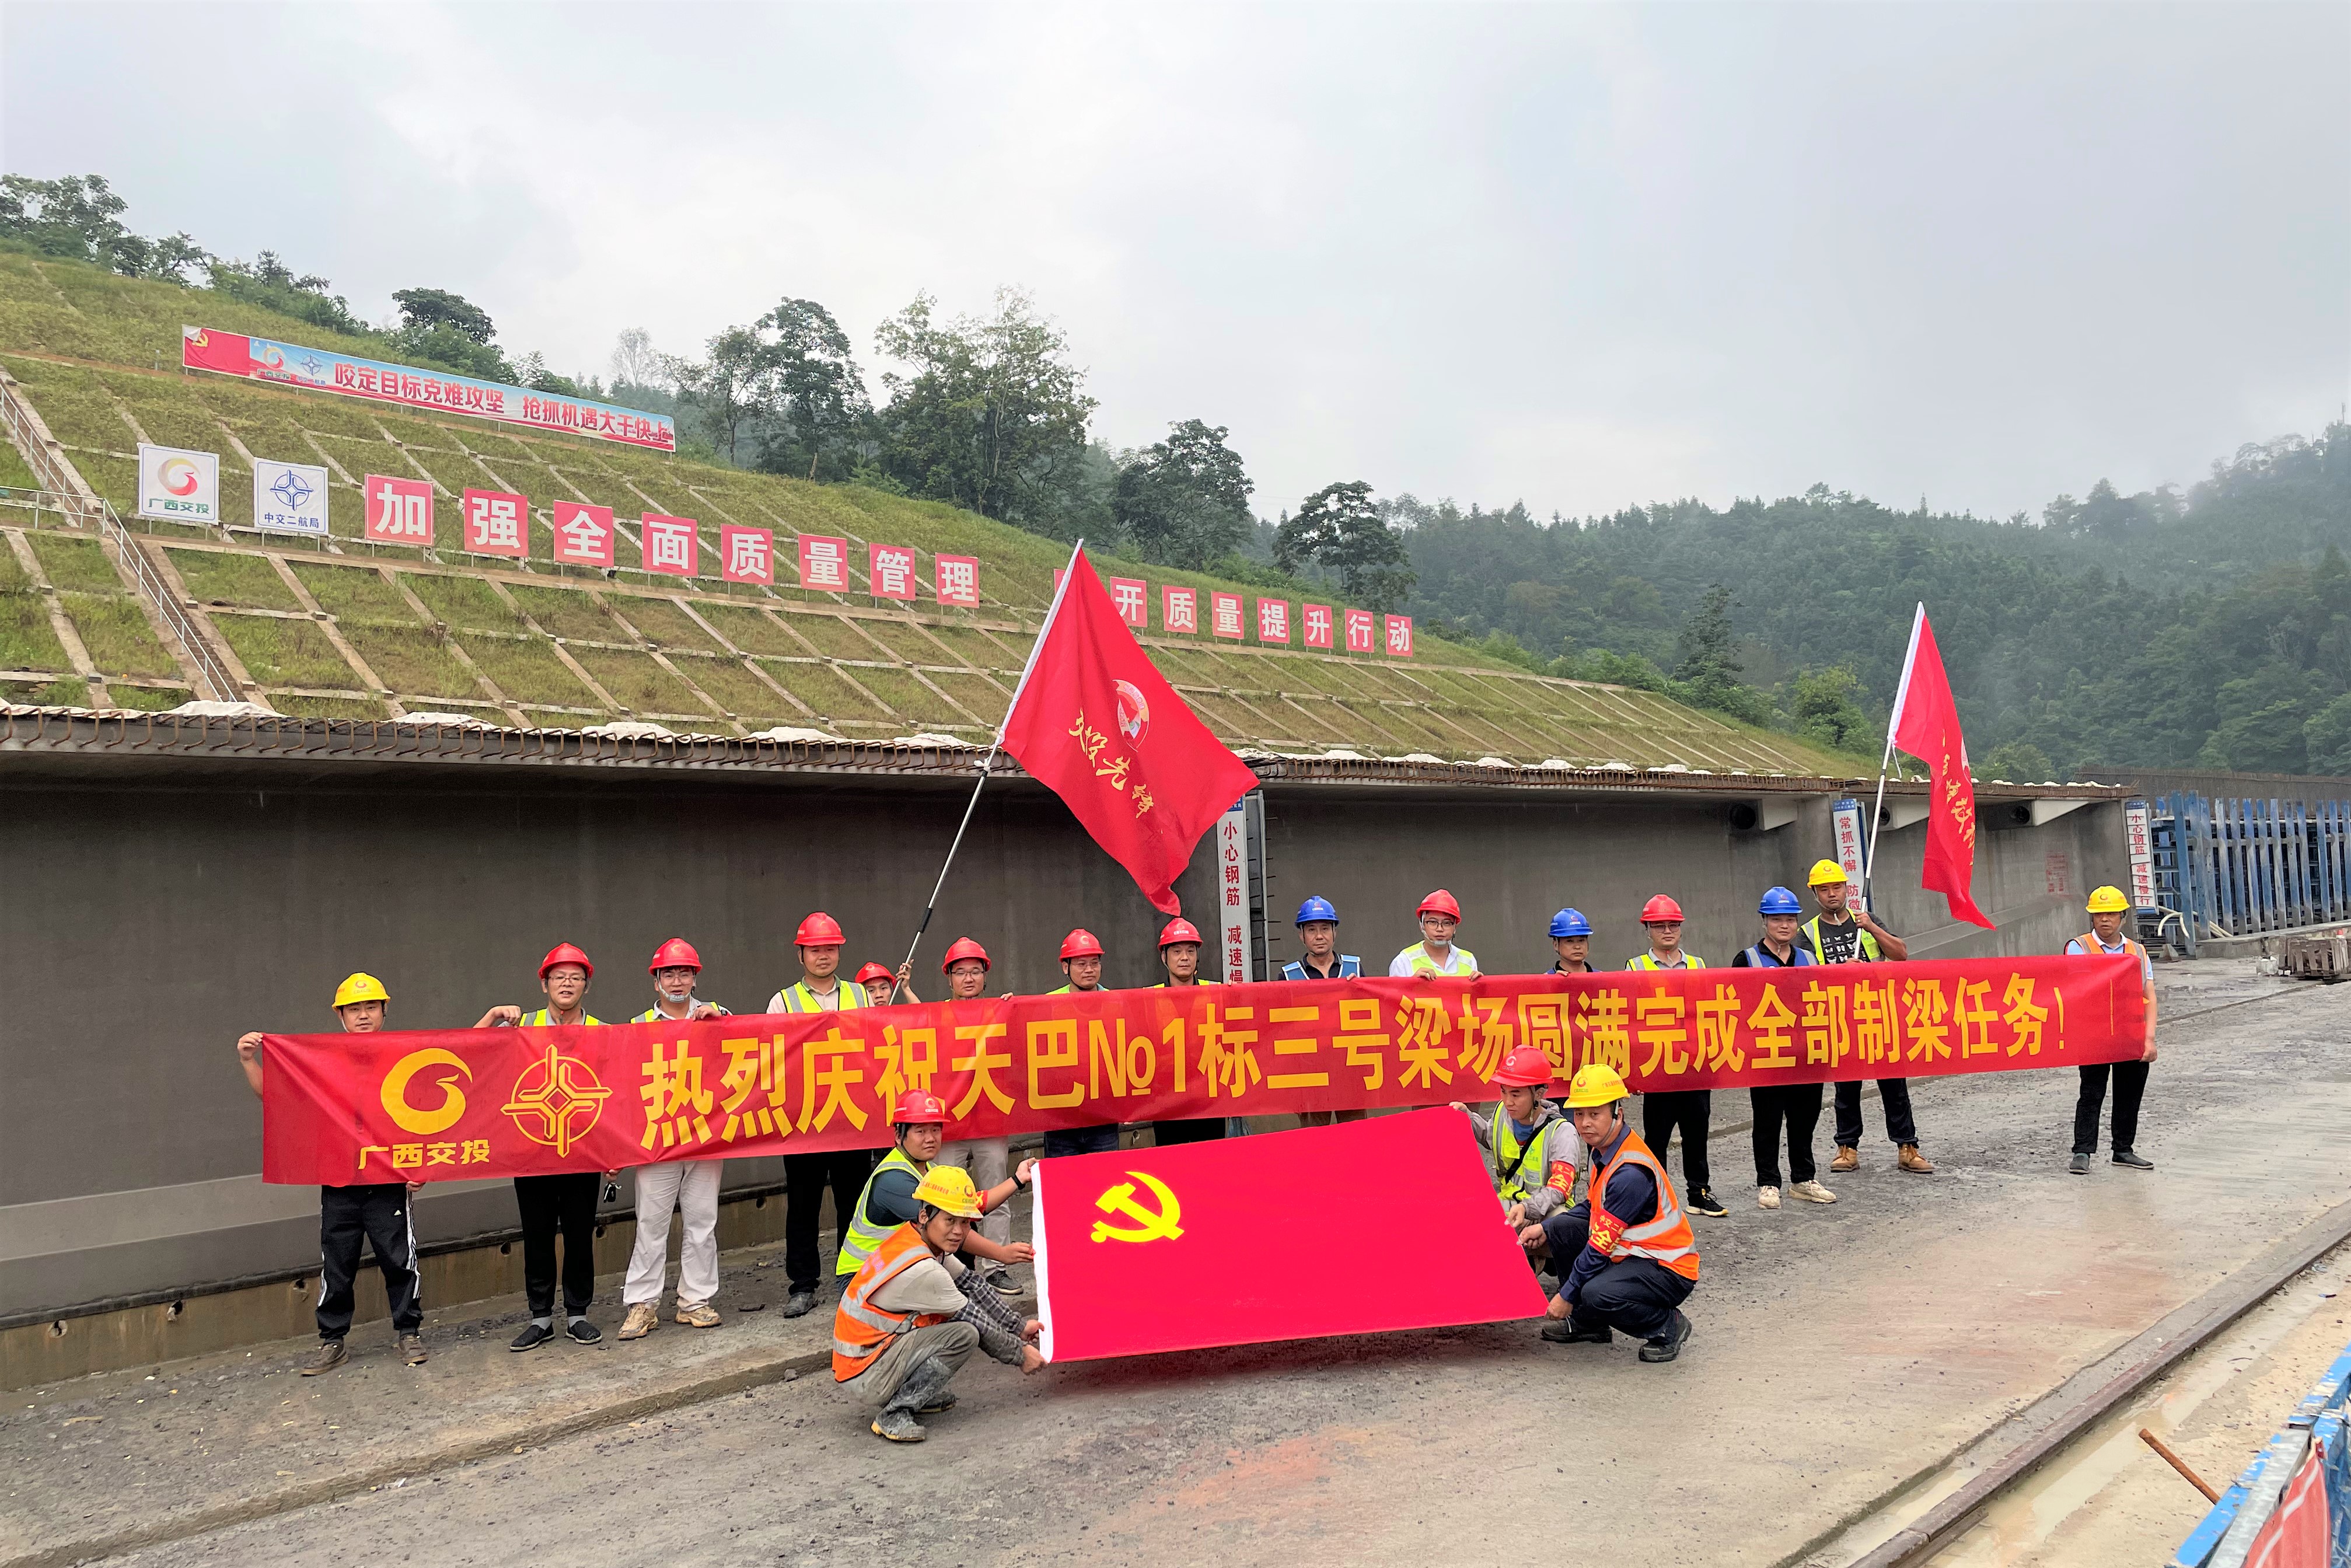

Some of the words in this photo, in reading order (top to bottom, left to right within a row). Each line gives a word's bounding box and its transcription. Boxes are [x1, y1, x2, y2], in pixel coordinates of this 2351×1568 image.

[335, 362, 504, 414] 咬定目标克难攻坚
[523, 395, 669, 442] 抢抓机遇大干快上
[148, 498, 209, 514] 广西交投
[264, 512, 319, 528] 中交二航局
[375, 483, 975, 602] 加强全面质量管理
[1839, 816, 1857, 872] 常抓不懈
[2132, 813, 2144, 855] 小心钢筋
[1224, 821, 1240, 906] 小心钢筋
[2136, 864, 2150, 906] 减速慢行
[358, 1139, 490, 1169] 广西交投
